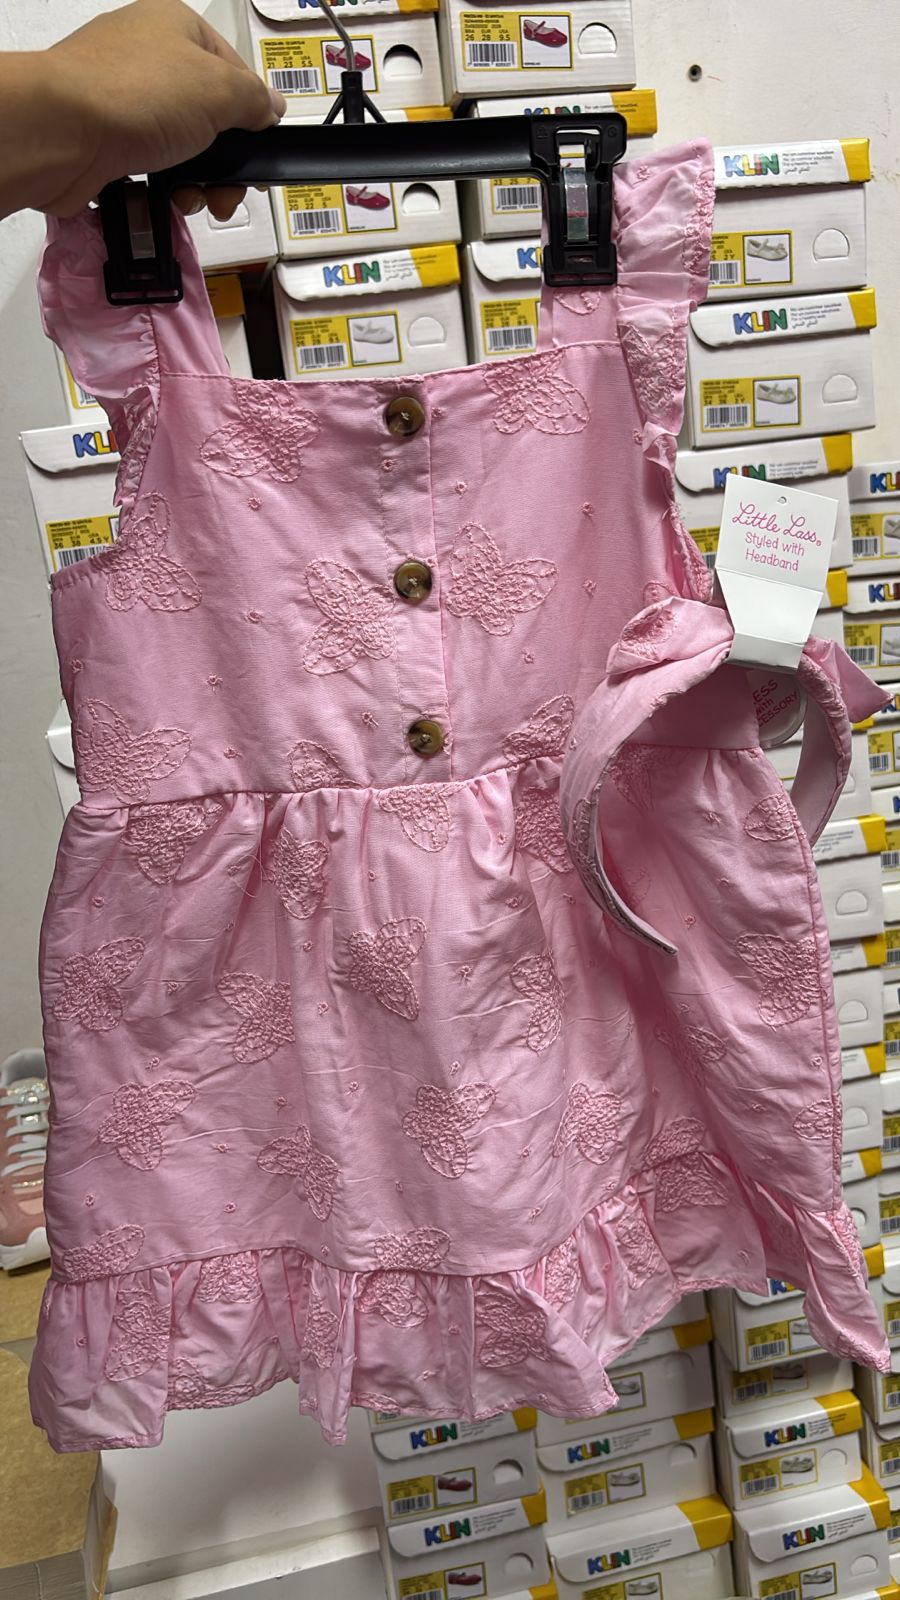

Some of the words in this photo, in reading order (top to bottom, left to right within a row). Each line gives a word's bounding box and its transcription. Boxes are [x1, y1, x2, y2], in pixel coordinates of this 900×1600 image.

[723, 153, 780, 177] KLIN
[323, 260, 382, 287] KLIN
[733, 308, 788, 335] KLIN
[732, 501, 781, 533] Little
[745, 531, 779, 549] Styled
[782, 542, 805, 557] with
[745, 548, 799, 571] Headband
[410, 1423, 458, 1449] KLIN
[764, 1422, 807, 1447] KLIN
[567, 1438, 610, 1463] KLIN
[424, 1518, 471, 1546] KLIN
[782, 1523, 825, 1550] KLIN
[587, 1549, 631, 1575] KLIN
